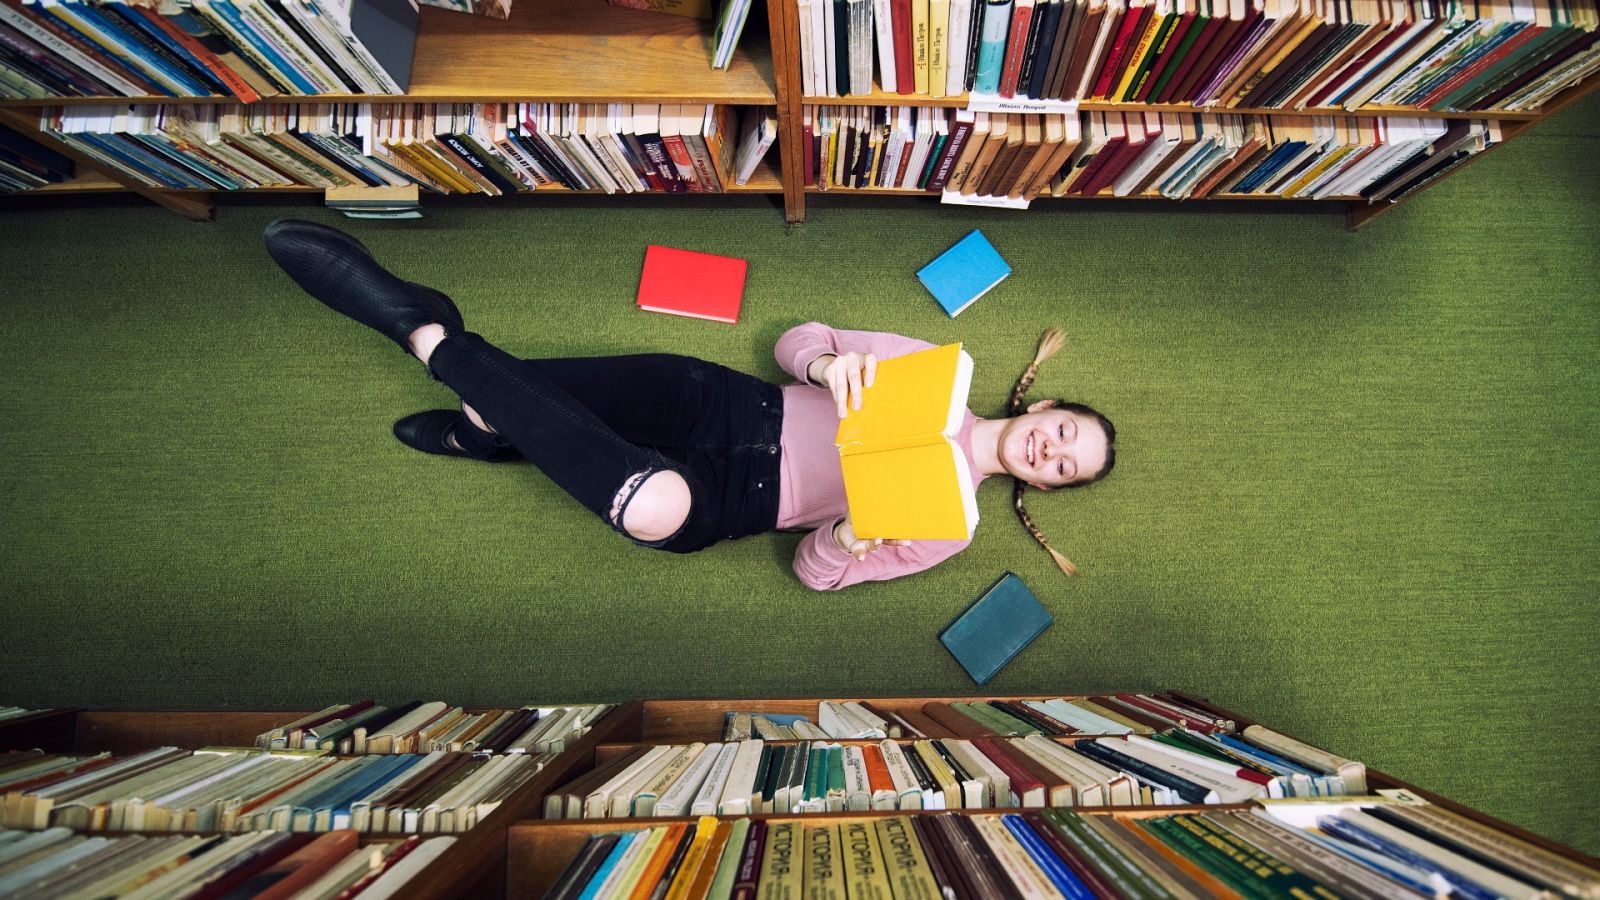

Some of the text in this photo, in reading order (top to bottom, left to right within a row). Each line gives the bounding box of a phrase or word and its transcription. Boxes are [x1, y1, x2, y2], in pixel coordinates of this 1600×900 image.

[771, 823, 793, 876] ИСТОРИЯ
[812, 826, 832, 880] ИСТОРИЯ
[849, 823, 873, 877] ИСТОРИЯ
[885, 817, 917, 870] ИСТОРИЯ
